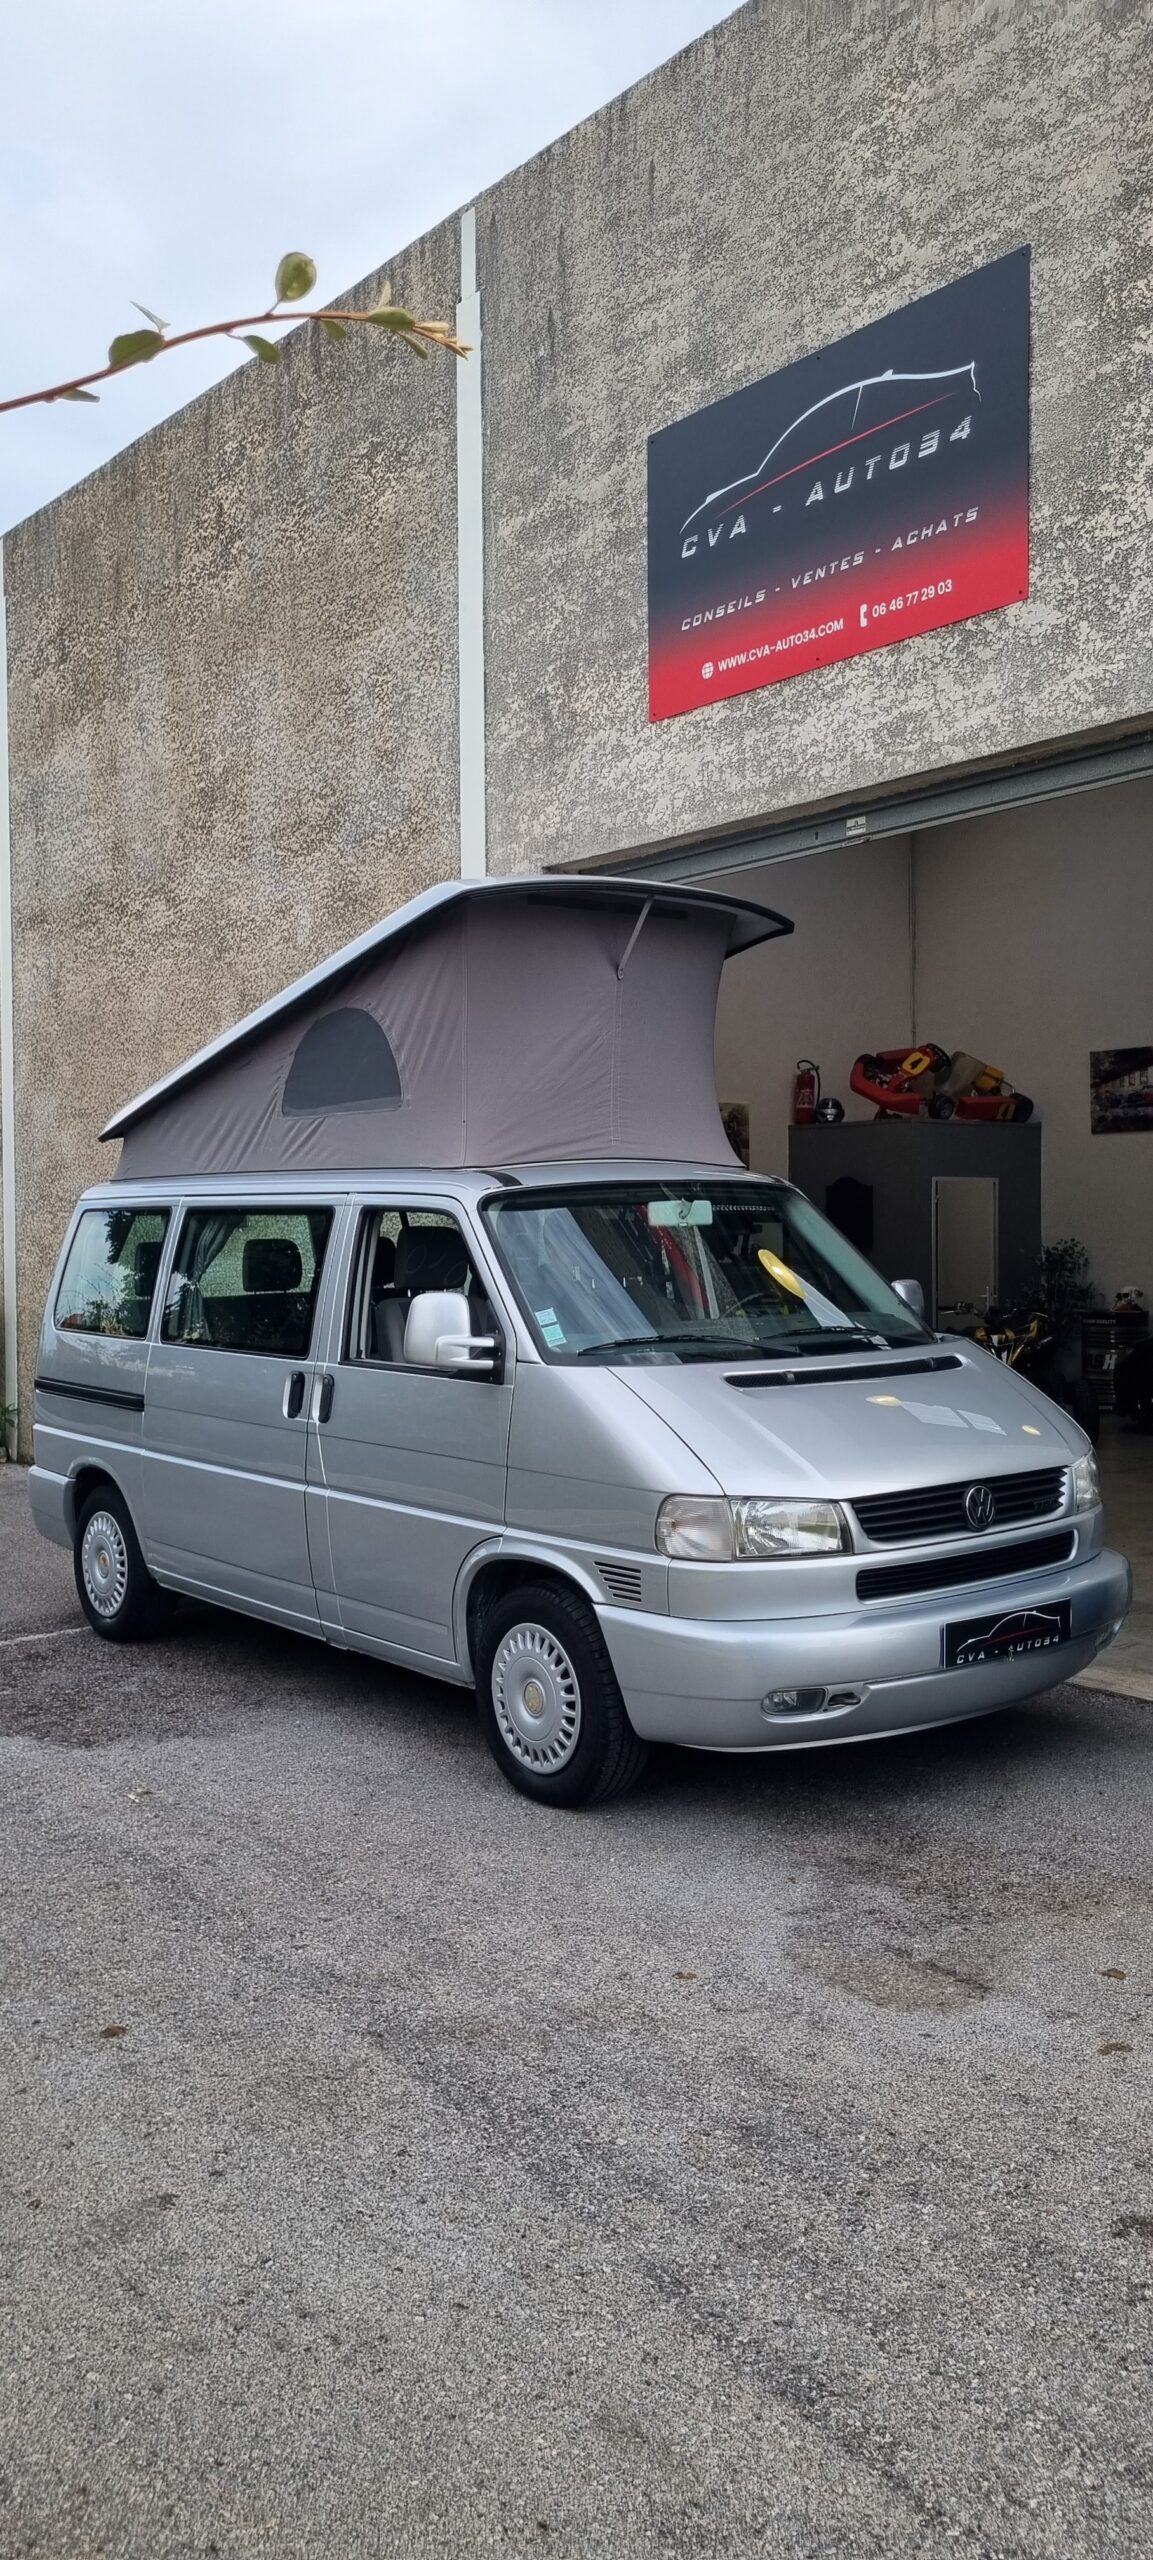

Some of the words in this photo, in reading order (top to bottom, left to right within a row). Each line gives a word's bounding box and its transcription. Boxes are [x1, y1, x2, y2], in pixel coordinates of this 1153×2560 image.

[681, 514, 747, 559] CVA
[805, 415, 972, 506] AUTO34
[681, 589, 766, 631] CONSEILS
[791, 551, 864, 590] VENTES
[891, 507, 979, 551] ACHATS
[872, 603, 887, 618] 06
[889, 597, 904, 612] 46
[906, 591, 919, 606] 77
[920, 585, 935, 601] 29
[937, 579, 953, 595] 03
[717, 618, 844, 672] WWW.CVA-AUTO34.COM
[956, 1649, 985, 1664] CVA
